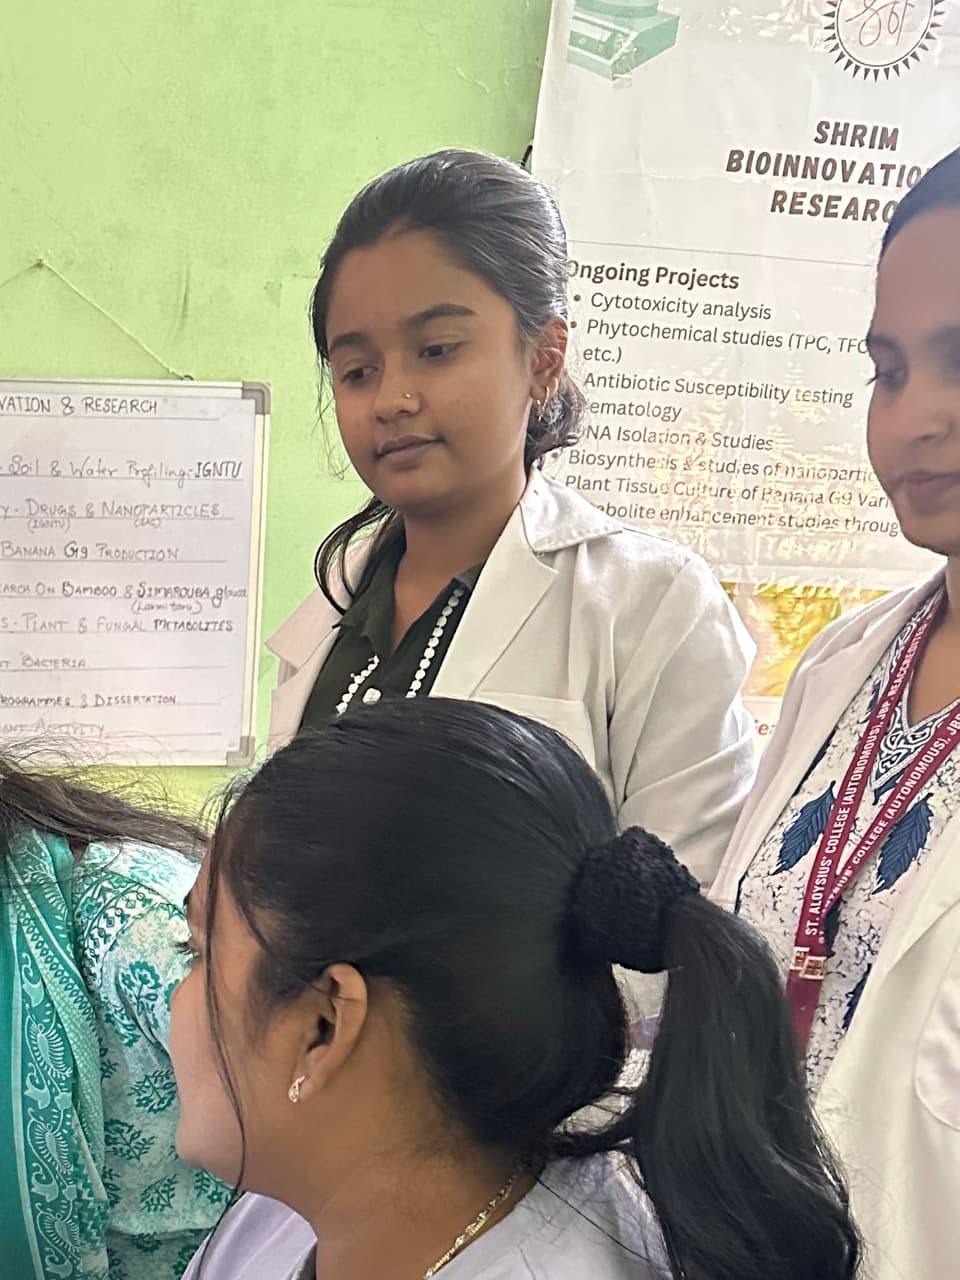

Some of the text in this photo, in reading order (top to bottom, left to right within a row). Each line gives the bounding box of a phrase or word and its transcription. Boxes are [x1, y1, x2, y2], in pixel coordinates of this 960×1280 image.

[814, 120, 899, 151] SHRIM
[726, 149, 930, 188] BIOINNOVATIO
[567, 260, 740, 290] Ongoing Projects
[591, 292, 772, 321] Cytotoxicity analysis
[587, 319, 718, 343] Phytochemical
[722, 330, 783, 348] studies
[788, 333, 831, 354] (TPC,
[583, 346, 622, 364] etc.)
[584, 373, 854, 408] Antibiotic Susceptibility testing
[60, 396, 75, 415] &
[588, 401, 682, 422] ematology
[581, 425, 774, 450] NA Isolation & Studies
[9, 455, 39, 476] Soil
[70, 456, 119, 479] Water
[763, 462, 782, 476] of
[565, 475, 611, 492] Plant
[616, 478, 669, 495] Tissue
[673, 481, 737, 499] Culture
[741, 486, 758, 500] of
[25, 498, 76, 518] DRUGS
[102, 500, 220, 518] NANOPARTICLES
[660, 506, 773, 526] enhancement
[778, 514, 839, 529] studies
[0, 541, 56, 558] BANANA
[96, 543, 180, 562] PRODUCTION
[62, 581, 117, 597] BAMBOO
[22, 612, 69, 631] PLANT
[95, 694, 177, 708] DISSERTATION
[825, 807, 850, 854] COLLEGE
[853, 819, 889, 864] COLLEGE
[809, 856, 832, 915] ALOYSIUS'
[806, 911, 820, 936] ST.
